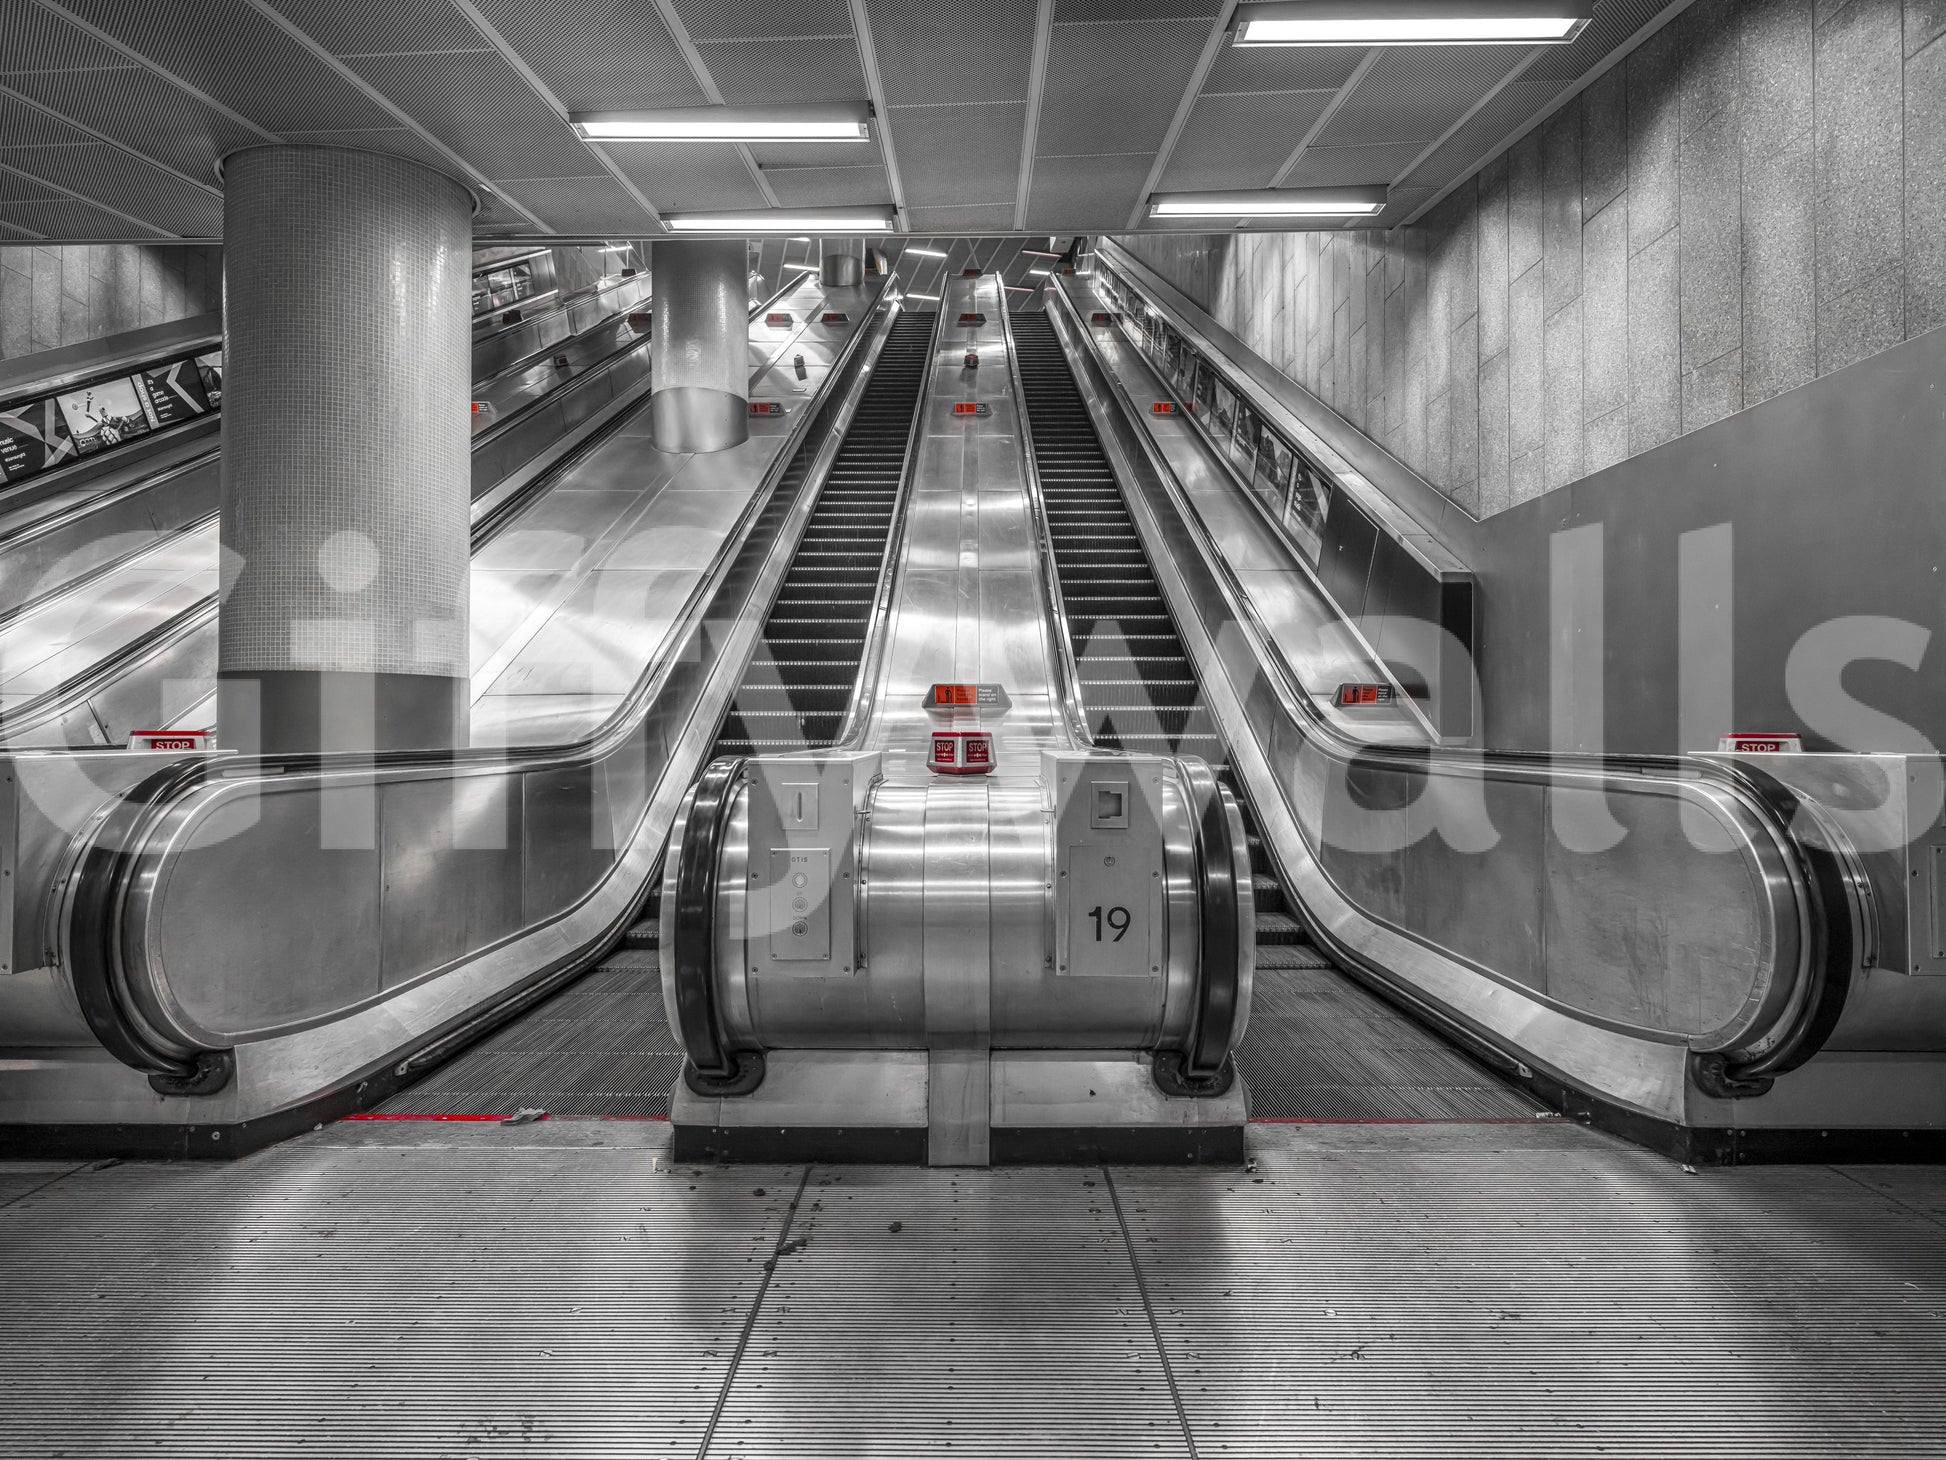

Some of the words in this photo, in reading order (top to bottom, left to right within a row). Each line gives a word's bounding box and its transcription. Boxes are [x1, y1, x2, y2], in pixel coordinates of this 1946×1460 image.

[137, 381, 149, 401] shop
[146, 408, 155, 422] Not
[0, 444, 18, 454] venue
[155, 741, 191, 750] STOP
[936, 742, 954, 751] STOP
[968, 742, 988, 752] STOP
[1741, 743, 1776, 752] STOP
[1088, 906, 1131, 942] 19
